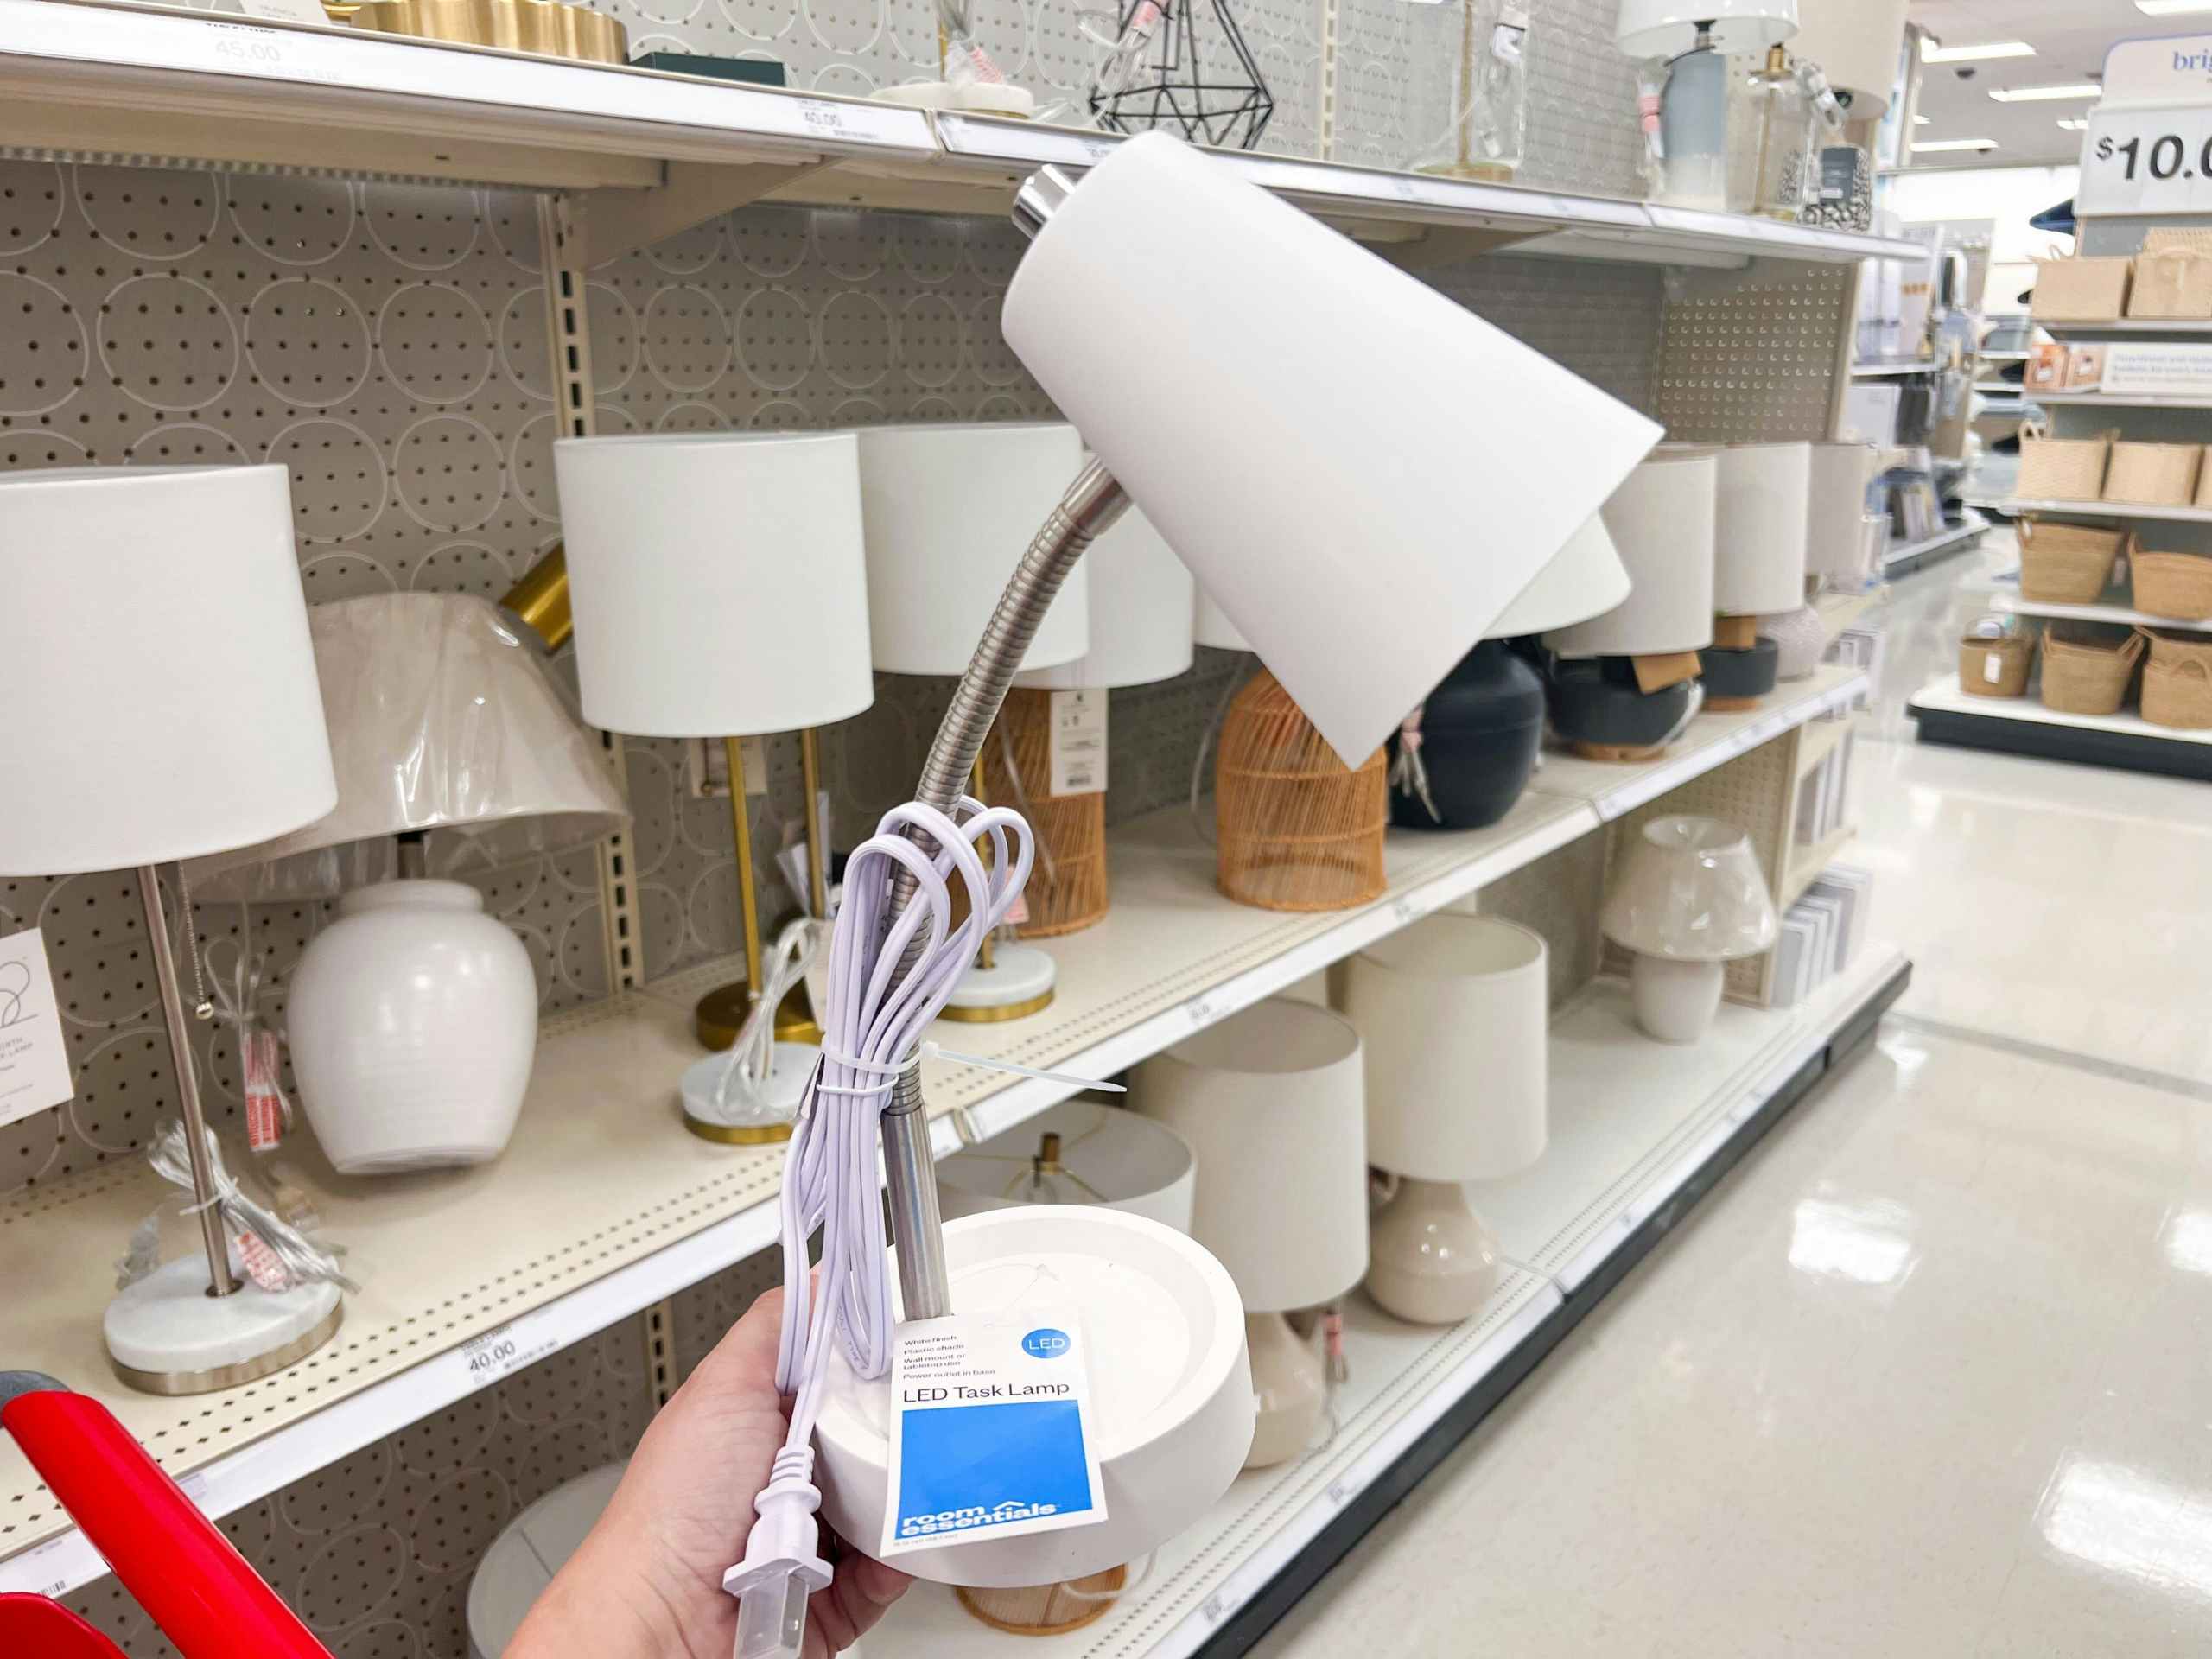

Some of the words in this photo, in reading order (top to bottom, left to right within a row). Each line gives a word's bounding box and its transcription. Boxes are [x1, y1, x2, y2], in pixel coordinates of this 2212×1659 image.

[216, 41, 282, 62] 45.00
[904, 1346, 935, 1355] Plastic
[1028, 1338, 1065, 1350] LED
[469, 1339, 517, 1371] 40.00
[925, 1353, 954, 1362] mount
[904, 1388, 948, 1403] LED
[952, 1384, 1003, 1400] Task
[1008, 1382, 1070, 1397] Lamp
[900, 1503, 1058, 1536] essentials
[902, 1506, 986, 1528] room
